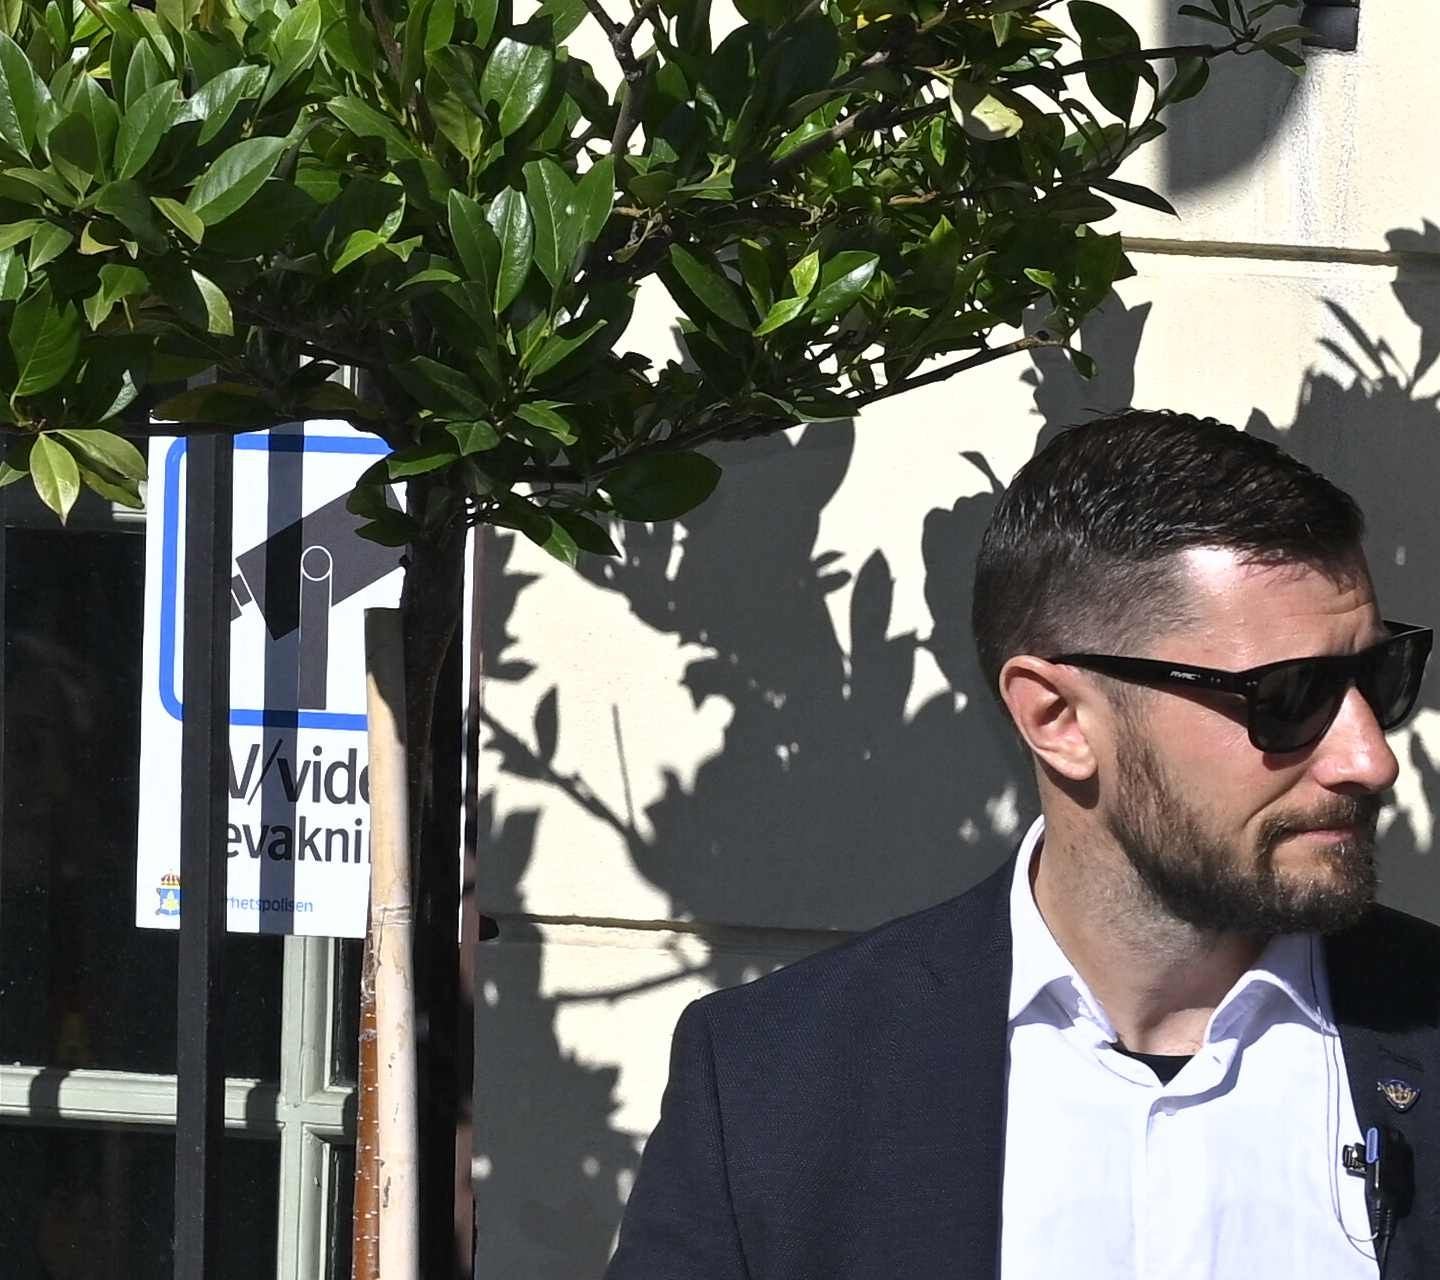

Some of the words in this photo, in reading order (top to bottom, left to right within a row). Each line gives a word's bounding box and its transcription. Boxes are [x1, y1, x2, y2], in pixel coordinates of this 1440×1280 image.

[229, 738, 369, 805] V/vid
[227, 816, 371, 864] evakni
[228, 896, 313, 913] hetspolisen
